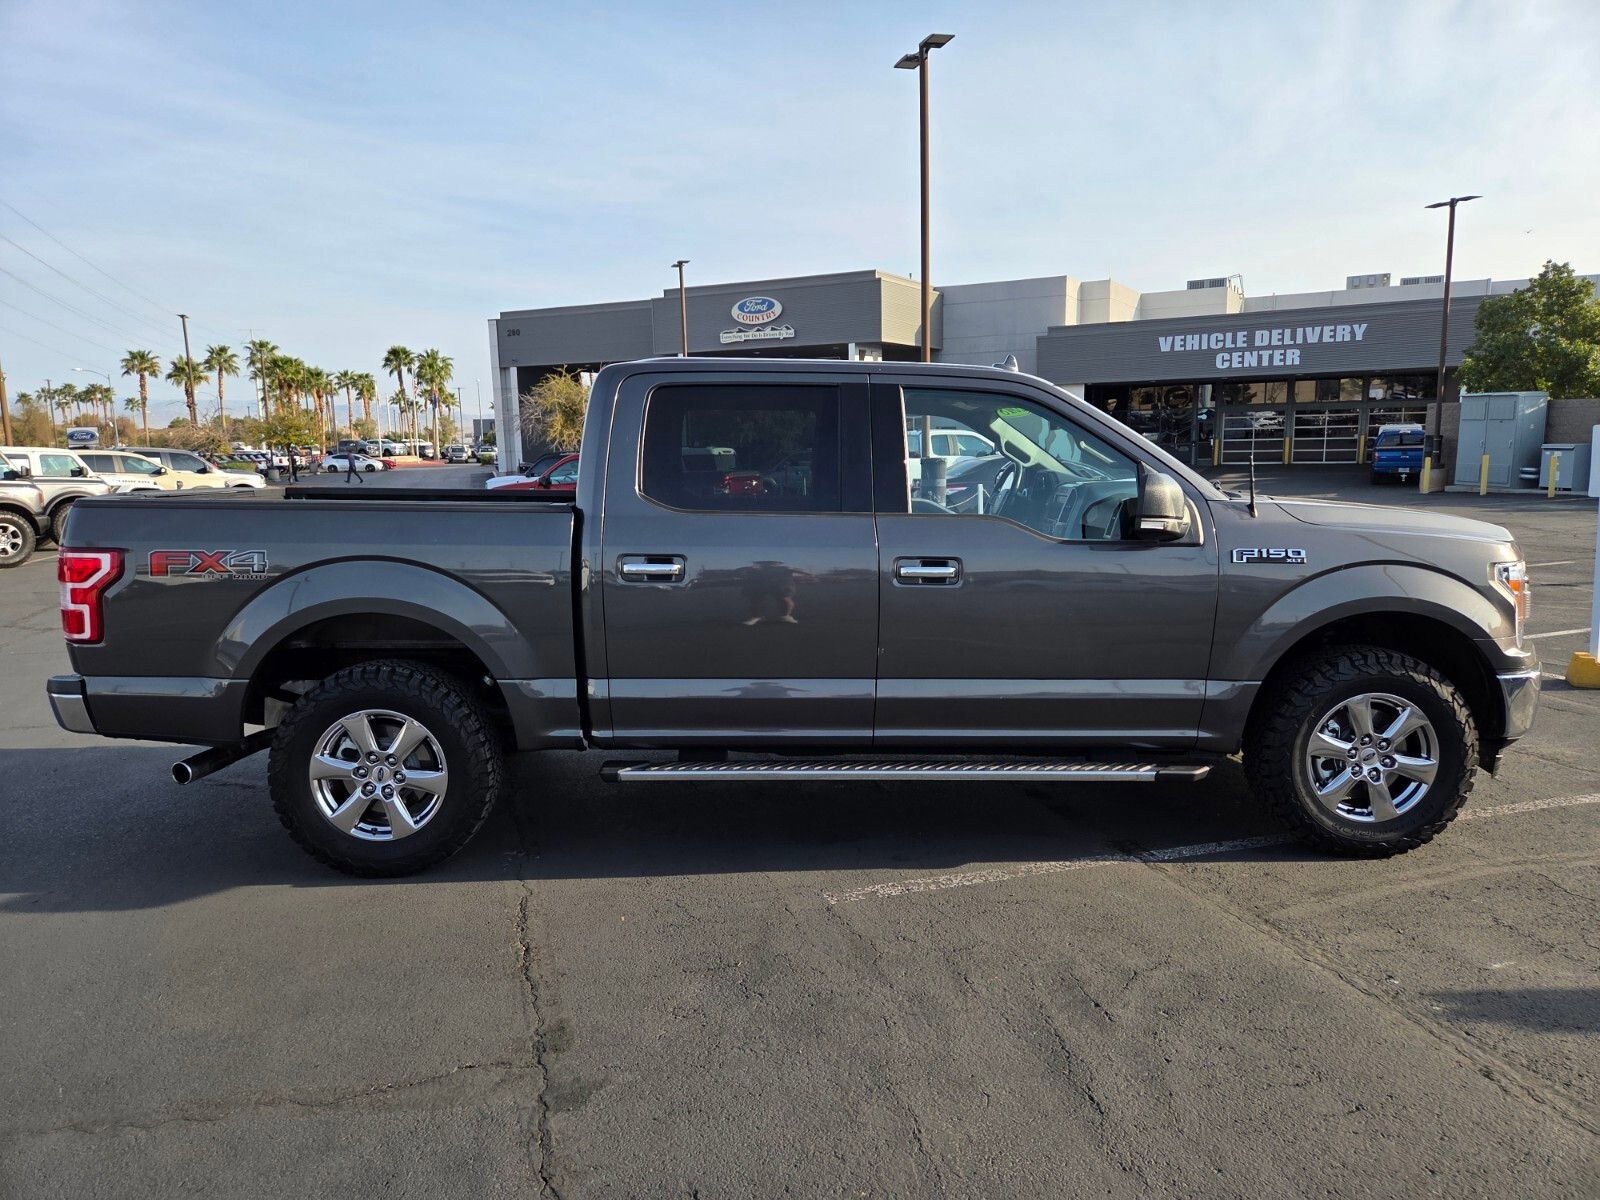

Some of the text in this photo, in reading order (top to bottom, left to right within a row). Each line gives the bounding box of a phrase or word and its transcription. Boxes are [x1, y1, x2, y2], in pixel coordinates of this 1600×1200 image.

[744, 300, 768, 312] Ford
[736, 311, 776, 322] COUNTRY
[1158, 323, 1368, 352] VEHICLE DELIVERY
[1215, 349, 1301, 369] CENTER
[148, 550, 268, 578] FX4
